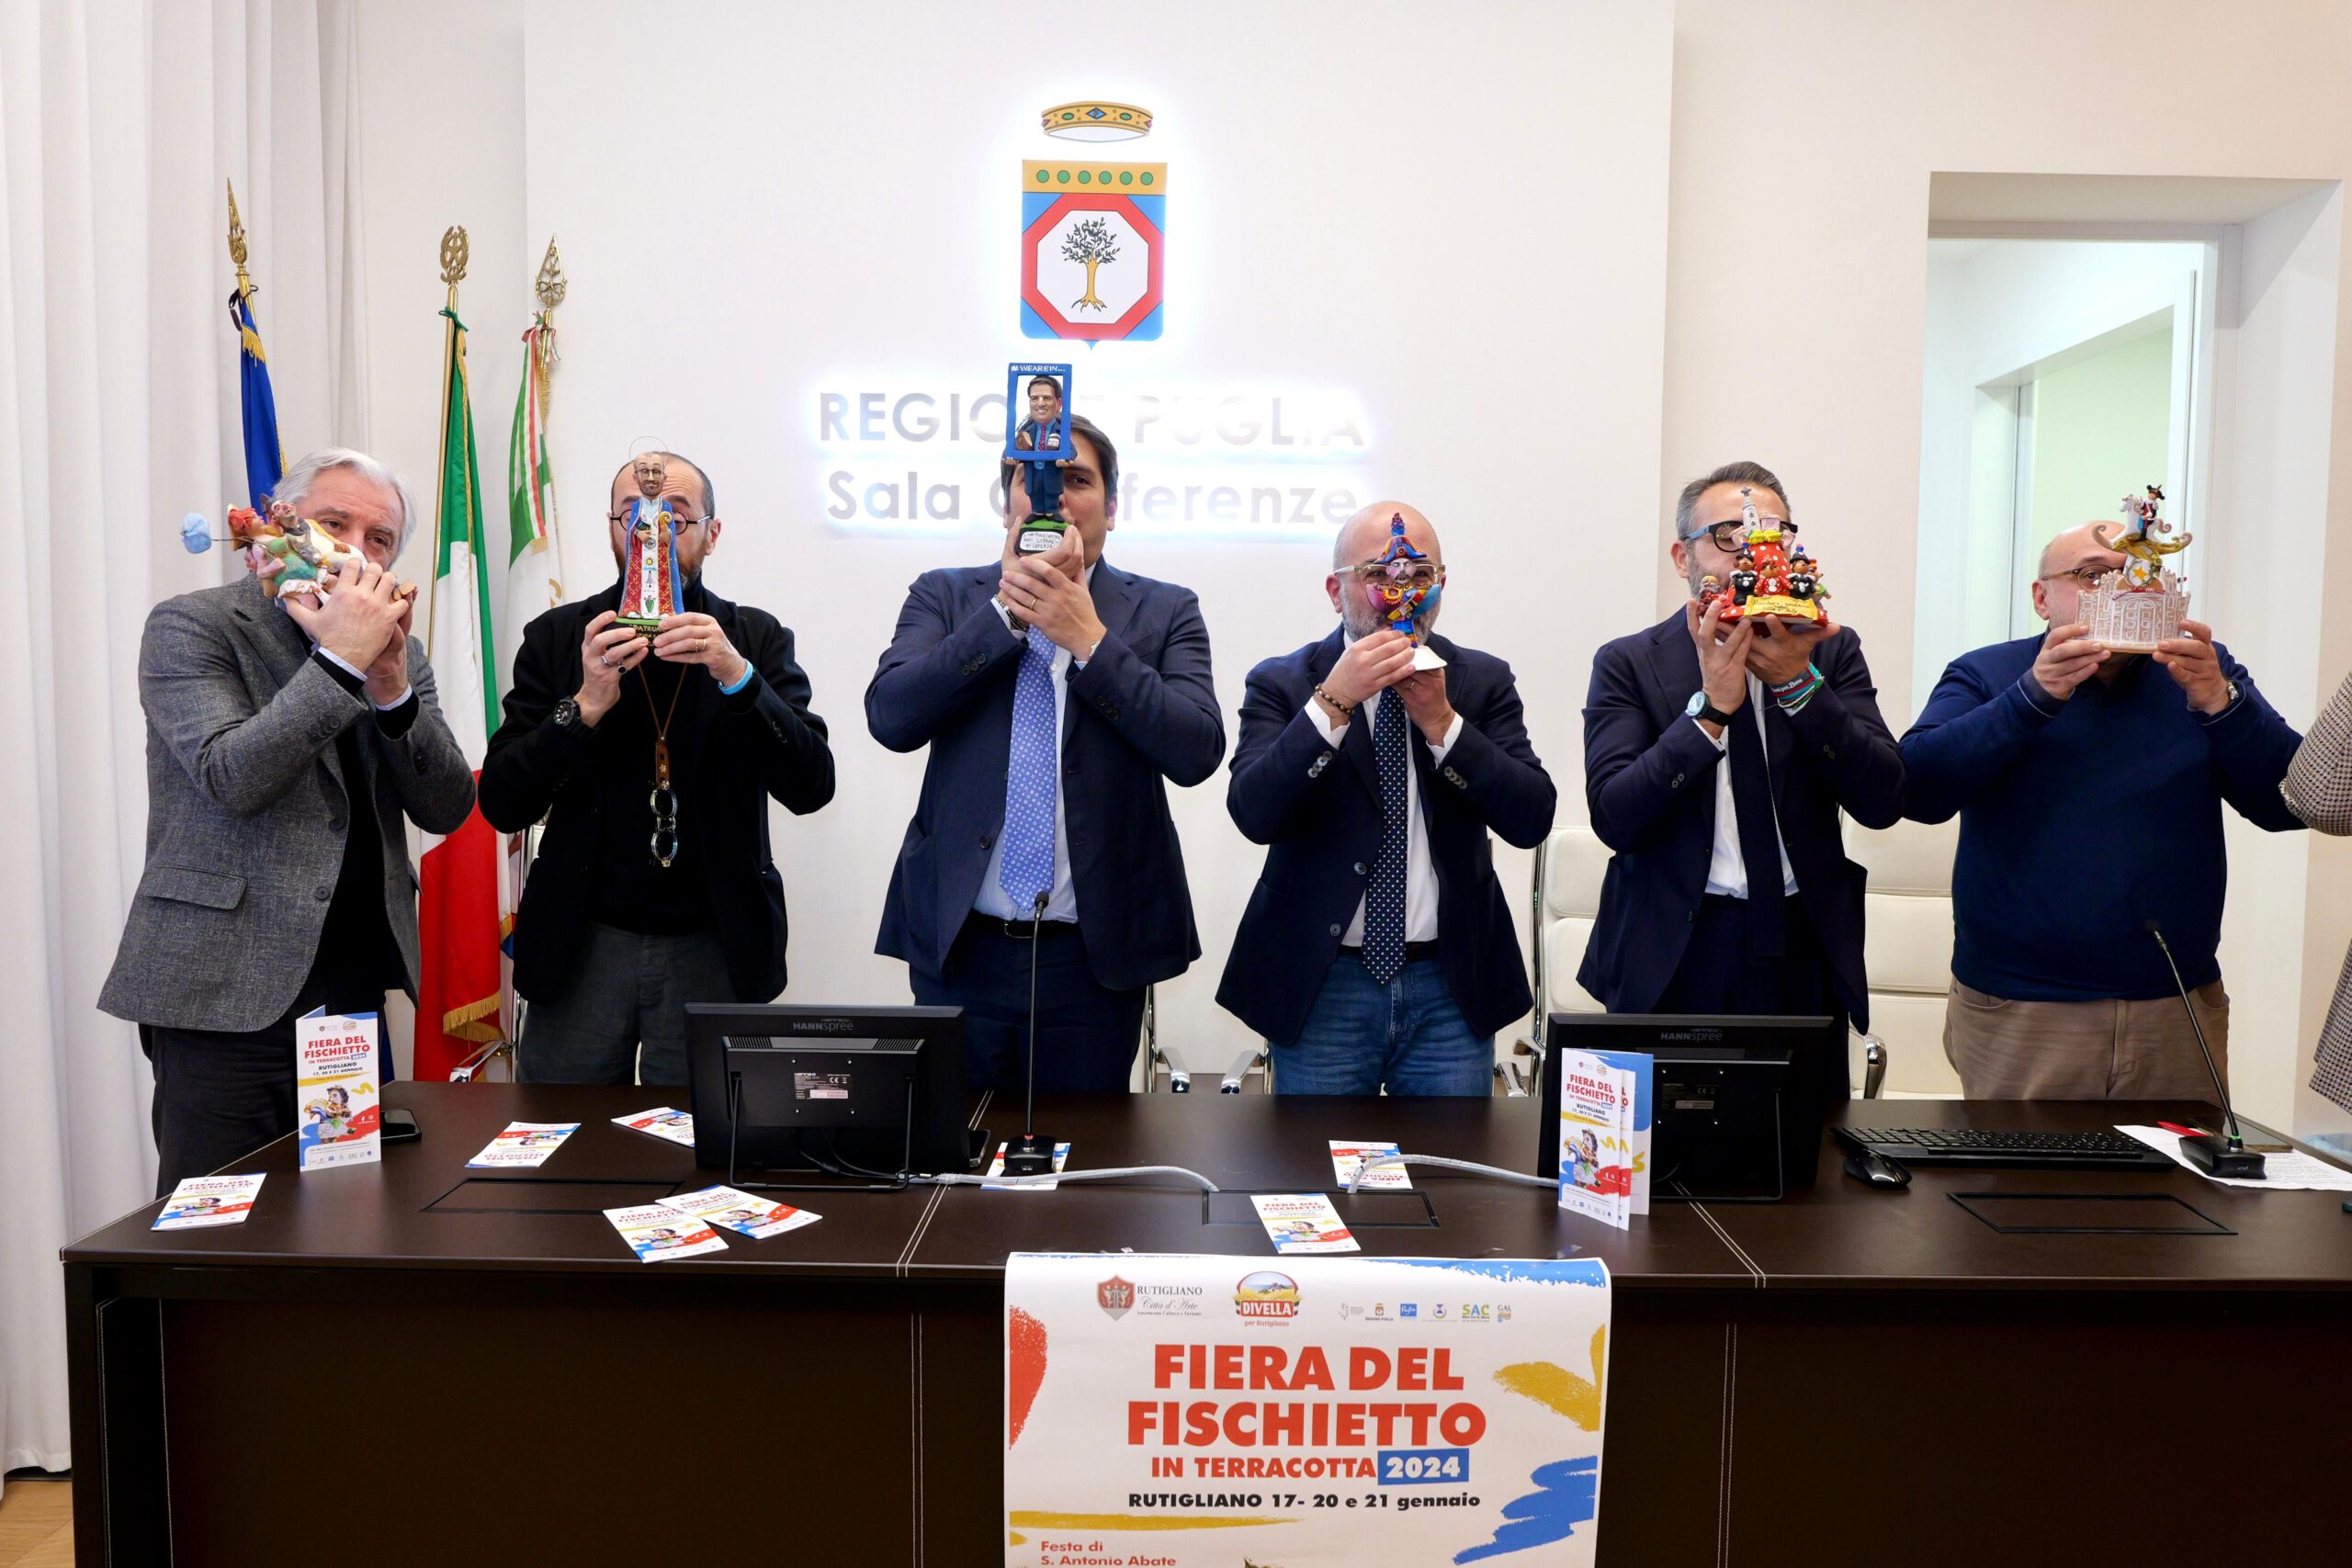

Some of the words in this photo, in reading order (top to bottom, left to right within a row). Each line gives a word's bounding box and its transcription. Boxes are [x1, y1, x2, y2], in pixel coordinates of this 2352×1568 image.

[827, 469, 961, 520] Sala
[793, 1021, 854, 1033] HANNspree
[308, 1038, 341, 1049] FIERA
[345, 1035, 367, 1045] DEL
[304, 1044, 370, 1059] FISCHIETTO
[318, 1062, 357, 1071] RUTIGLIANO
[1569, 1074, 1595, 1088] FIERA
[1598, 1081, 1613, 1093] DEL
[1566, 1083, 1616, 1104] FISCHIETTO
[1577, 1103, 1606, 1116] RUTIGLIANO
[1136, 1285, 1203, 1296] RUTIGLIANO
[1242, 1301, 1293, 1316] DIVELLA
[1462, 1303, 1490, 1316] SAC
[1256, 1319, 1290, 1327] Rutigliano
[1154, 1344, 1336, 1391] FIERA
[1348, 1346, 1464, 1391] DEL
[1127, 1400, 1487, 1448] FISCHIETTO
[1151, 1456, 1183, 1478] IN
[1193, 1456, 1377, 1479] TERRACOTTA
[1385, 1456, 1461, 1479] 2024
[1128, 1493, 1263, 1508] RUTIGLIANO
[1312, 1493, 1340, 1508] 20
[1345, 1496, 1358, 1508] e
[1364, 1493, 1389, 1507] 21
[1396, 1492, 1481, 1511] gennaio
[1041, 1540, 1083, 1552] Festa
[1088, 1540, 1103, 1552] di
[1041, 1555, 1055, 1566] S.
[1059, 1555, 1124, 1566] Antonio
[1127, 1555, 1177, 1567] Abate
